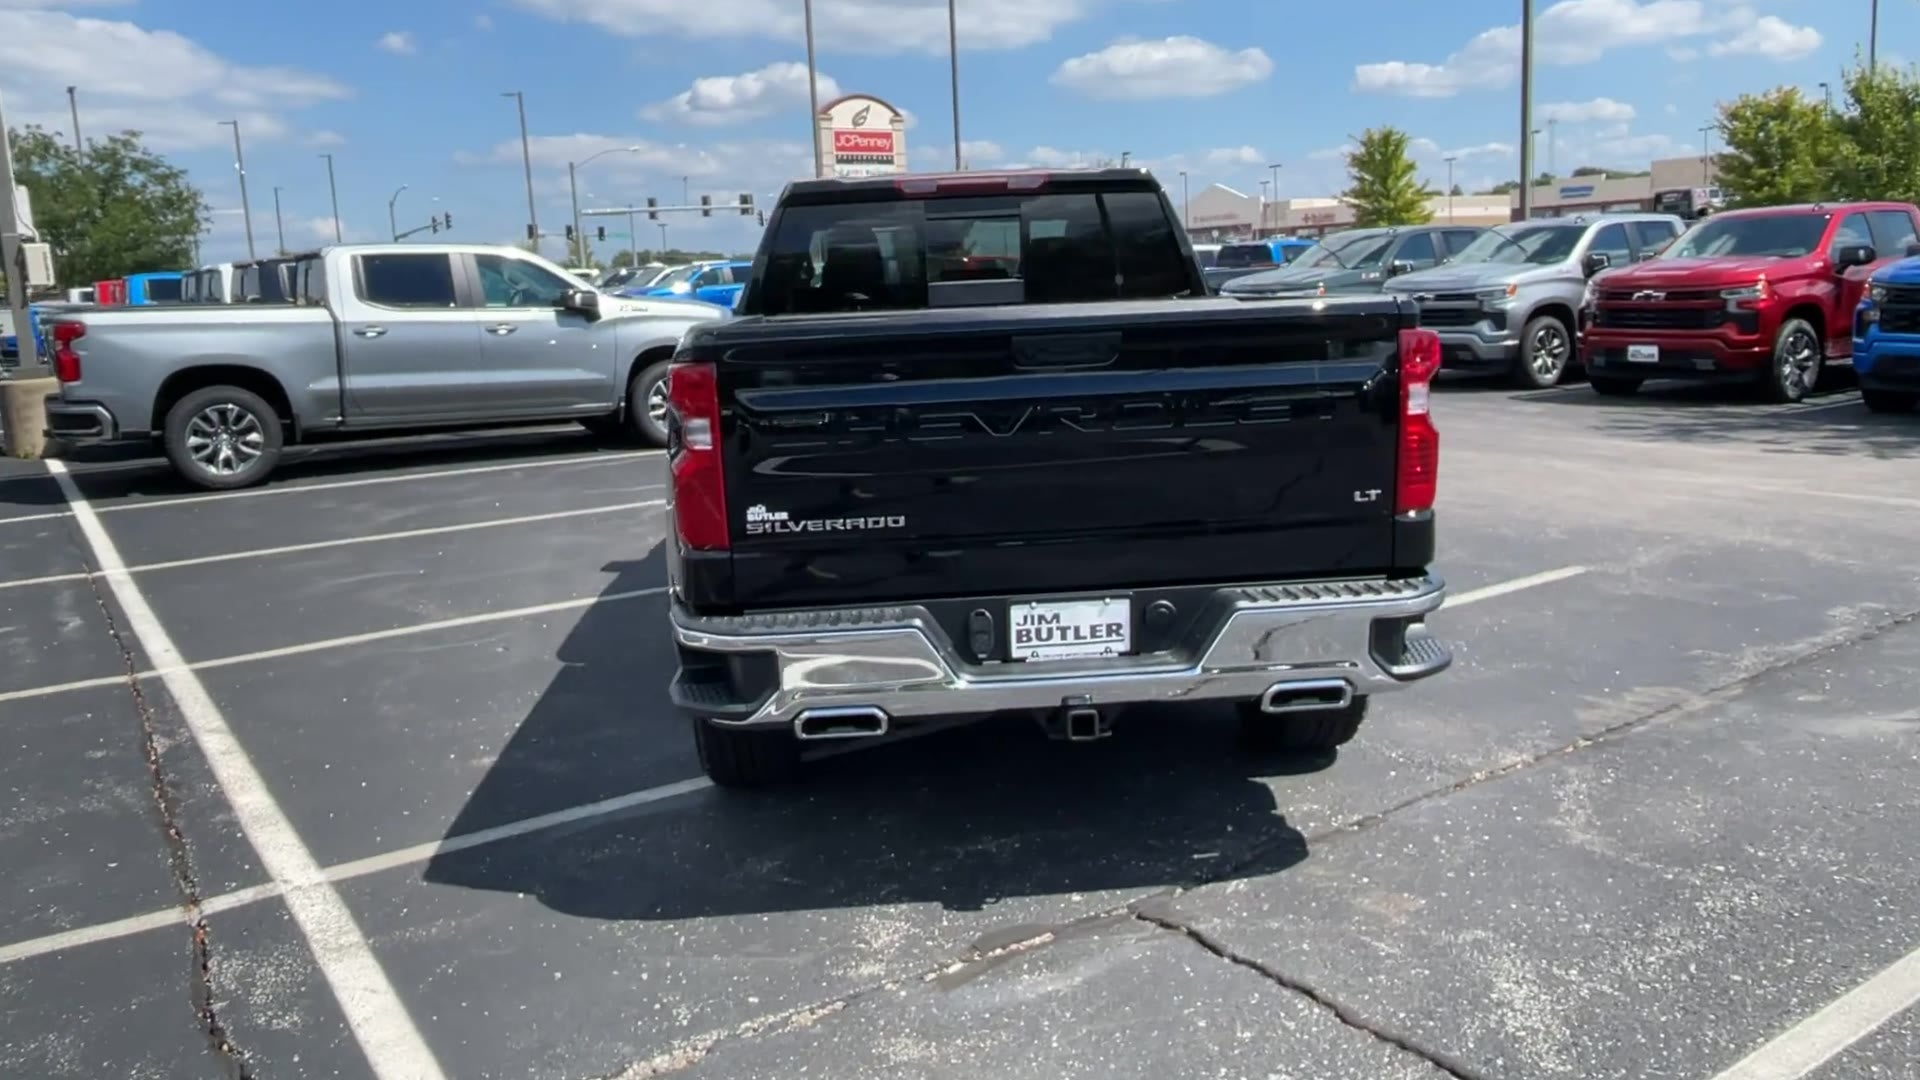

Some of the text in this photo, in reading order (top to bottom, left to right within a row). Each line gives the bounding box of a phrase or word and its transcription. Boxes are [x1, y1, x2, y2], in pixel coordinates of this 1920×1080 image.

[836, 134, 892, 150] JCPenney
[1353, 489, 1382, 502] LT
[746, 515, 906, 535] SILVERADO
[1015, 612, 1060, 627] JIM
[1015, 622, 1125, 645] BUTLER
